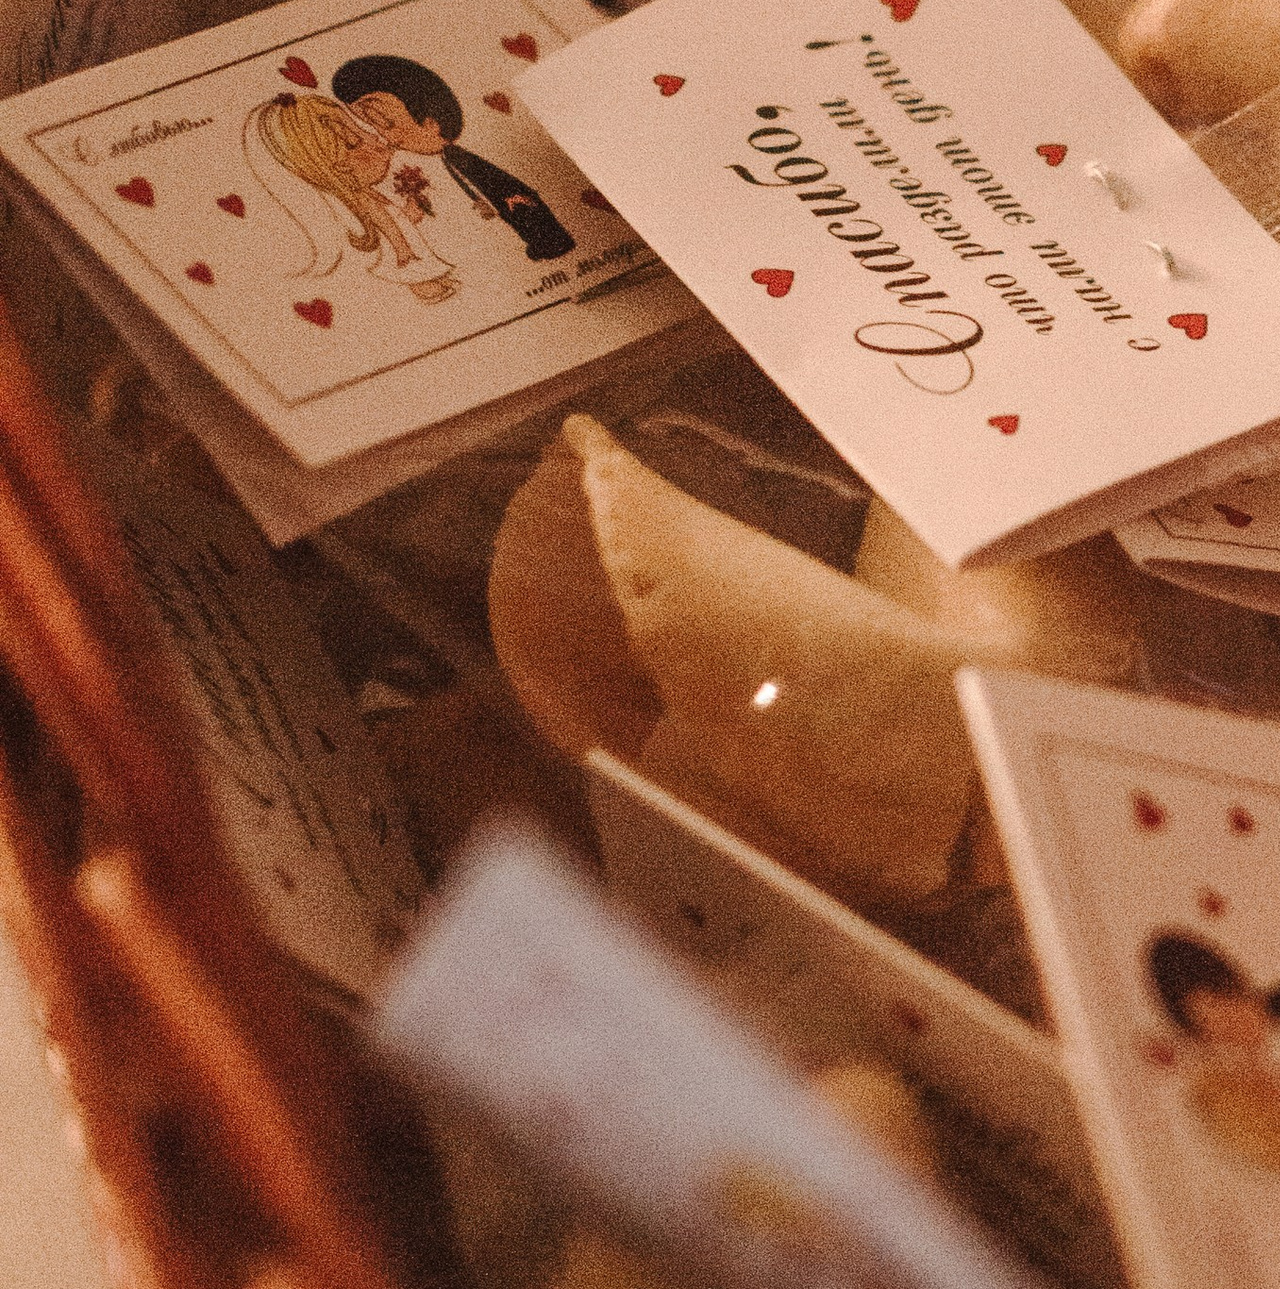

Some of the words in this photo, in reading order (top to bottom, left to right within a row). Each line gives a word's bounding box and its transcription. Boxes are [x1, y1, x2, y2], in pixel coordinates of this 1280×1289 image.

[805, 33, 953, 125] день!
[820, 97, 1004, 261] разделили
[936, 136, 1035, 226] этот
[724, 105, 984, 395] Спасибо,
[1031, 240, 1132, 325] нами
[985, 273, 1057, 337] что
[1128, 337, 1162, 353] с
